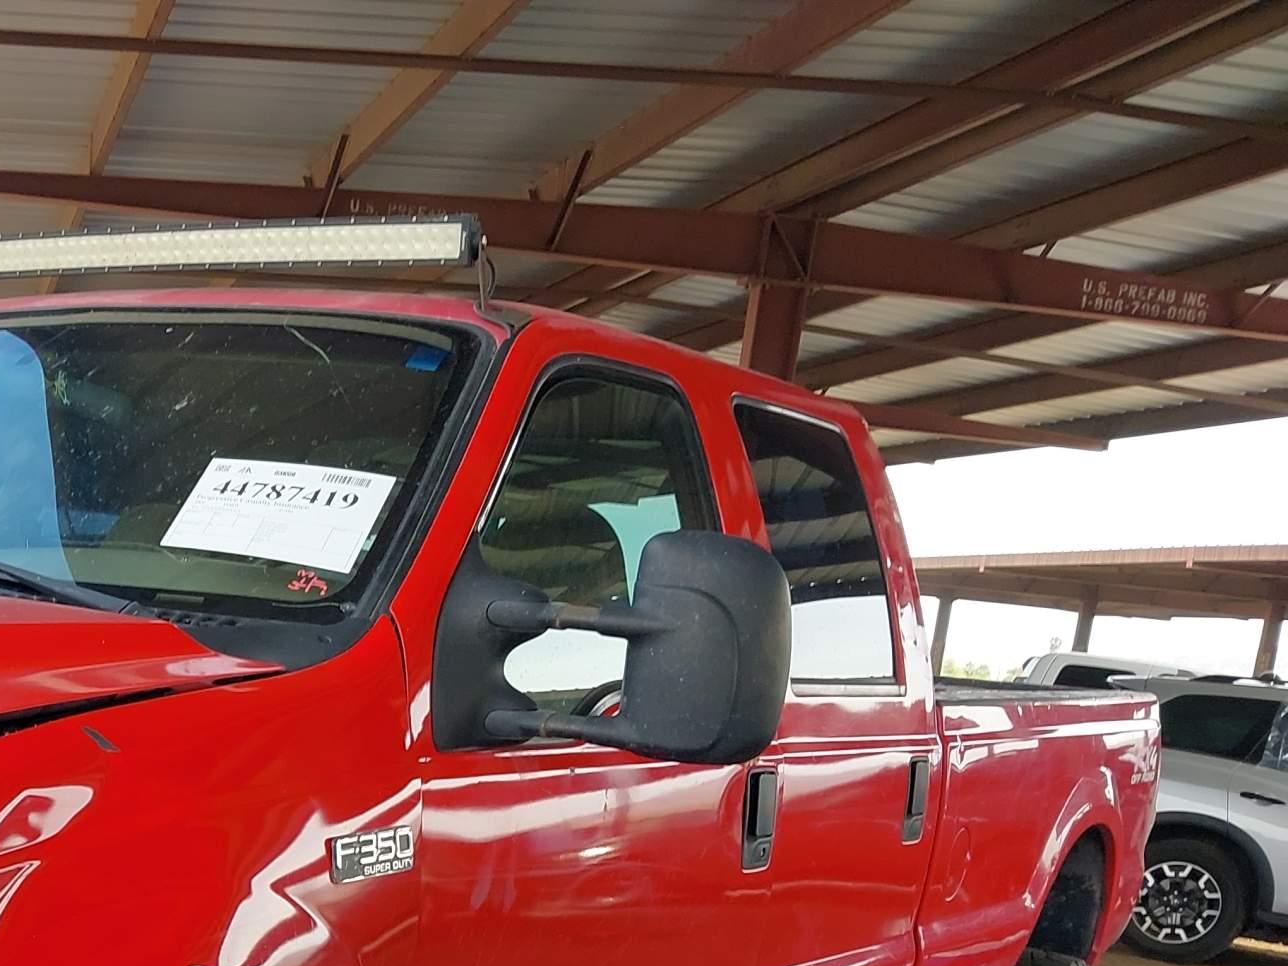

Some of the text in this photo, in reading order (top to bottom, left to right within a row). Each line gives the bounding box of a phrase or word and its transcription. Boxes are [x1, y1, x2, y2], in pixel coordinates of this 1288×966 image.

[1083, 278, 1210, 309] U.S. PREFAB INC.
[212, 479, 359, 509] 44787419
[364, 858, 414, 876] SUPER DUTY
